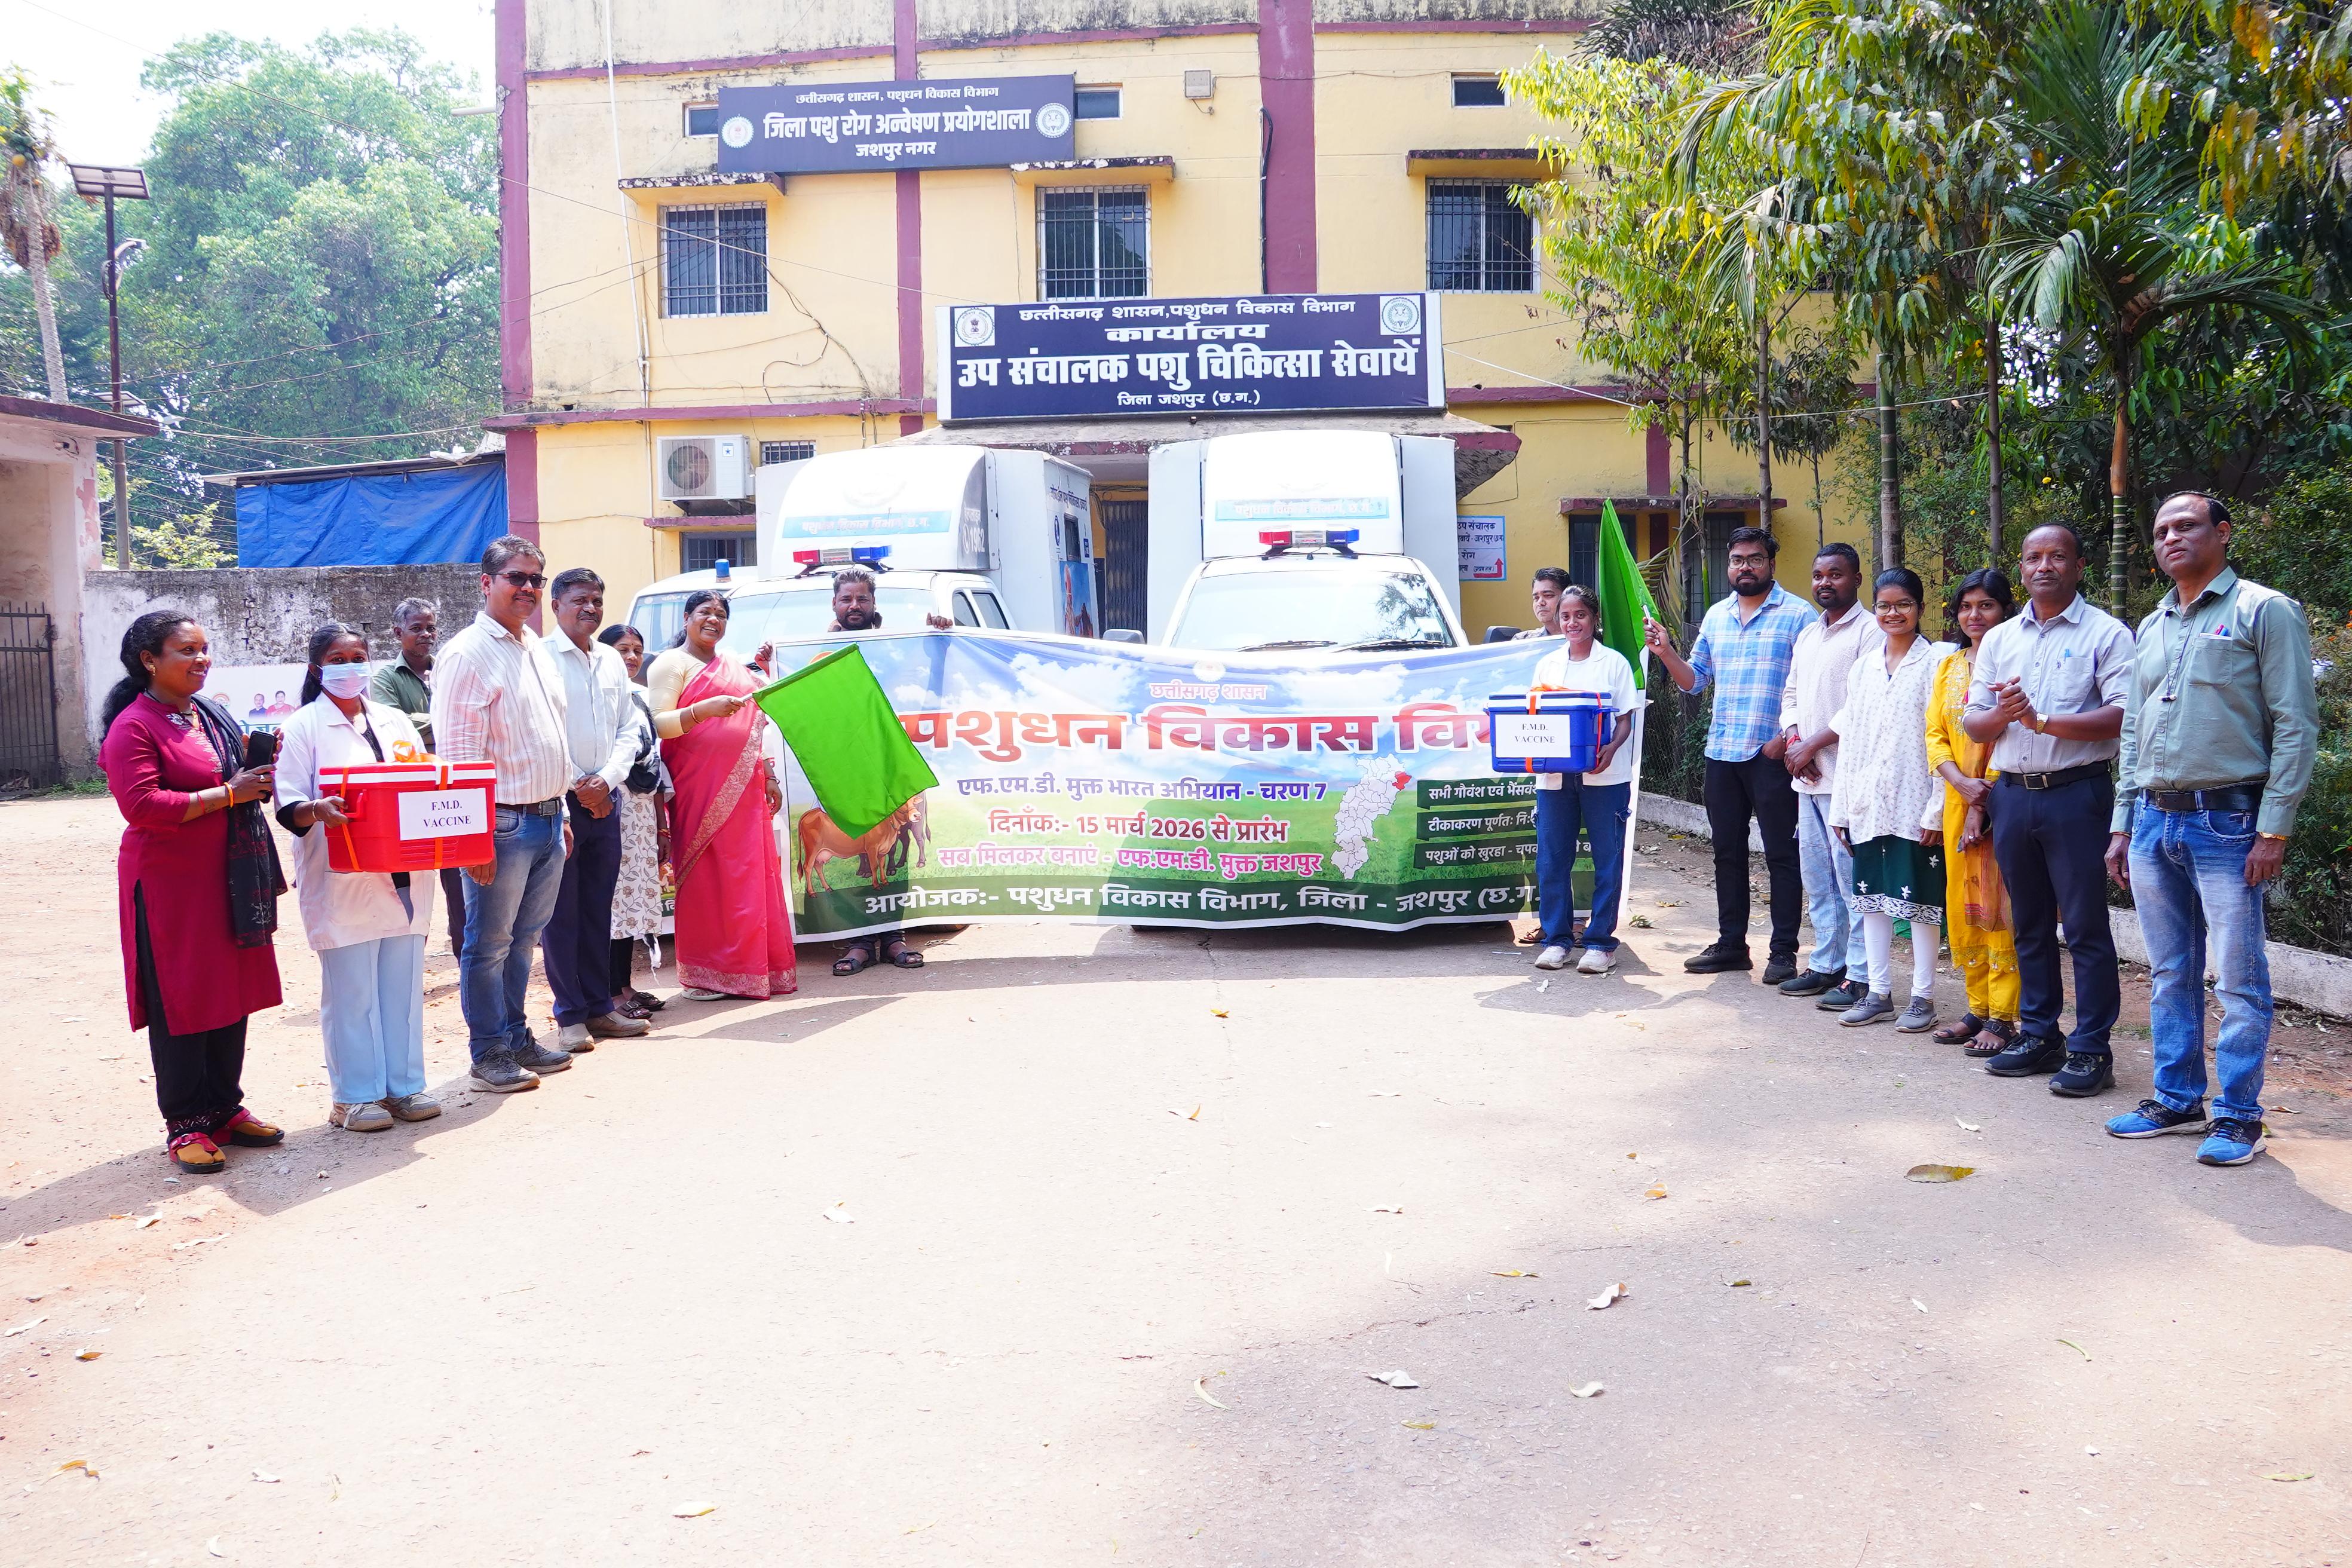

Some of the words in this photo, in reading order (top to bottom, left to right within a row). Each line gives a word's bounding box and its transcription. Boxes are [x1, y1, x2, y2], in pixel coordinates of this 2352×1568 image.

[847, 91, 884, 102] शासन,
[887, 90, 923, 103] पशुधन
[925, 87, 961, 99] विकास
[963, 85, 999, 97] विभाग
[763, 112, 808, 139] जिला
[809, 116, 839, 143] पशु
[840, 109, 872, 136] रोग
[875, 106, 941, 134] अन्वेषण
[942, 105, 1032, 133] प्रयोगशाला
[855, 142, 904, 161] जशपुर
[904, 142, 937, 155] नगर
[1019, 305, 1104, 321] छत्तीसगढ़
[1236, 299, 1295, 316] विकास
[1302, 298, 1355, 314] विभाग
[1104, 321, 1270, 342] कार्यालय
[956, 359, 1001, 387] उप
[1007, 347, 1130, 385] संचालक
[1136, 352, 1192, 391] पशु
[1197, 342, 1324, 380] चिकित्सा
[1330, 338, 1421, 377] सेवायें
[1117, 391, 1153, 406] जिला
[1158, 393, 1205, 408] जशपुर
[1212, 389, 1261, 407] (छ.ग.)
[1468, 520, 1496, 532] संचालक
[969, 527, 985, 553] 1962
[1474, 535, 1493, 544] जशपुर
[1461, 549, 1475, 561] रोग
[1151, 681, 1219, 701] छत्तीसगढ़
[1223, 685, 1266, 699] शासन
[899, 710, 1127, 762] पशुधन
[1141, 705, 1379, 751] विकास
[957, 771, 1061, 795] एफ.एम.डी.
[1065, 777, 1104, 801] मुक्त
[1108, 779, 1154, 797] भारत
[1160, 777, 1241, 800] अभियान
[1260, 783, 1309, 800] चरण
[1315, 783, 1327, 800] 7
[1429, 784, 1451, 800] सभी
[1454, 783, 1484, 798] गौवंश
[1487, 782, 1505, 797] एवं
[431, 800, 462, 811] F.M.D.
[424, 816, 471, 828] VACCINE
[1076, 816, 1098, 834] 15
[1105, 811, 1146, 835] मार्च
[1152, 819, 1205, 839] 2026
[1211, 814, 1231, 841] से
[1236, 816, 1287, 841] प्रारंभ
[1428, 817, 1482, 831] टीकाकरण
[939, 849, 971, 865] सब
[976, 843, 1045, 865] मिलकर
[1049, 844, 1098, 865] बनाएं
[1116, 847, 1214, 870] एफ.एम.डी.
[1220, 855, 1257, 878] मुक्त
[1262, 855, 1322, 875] जशपुर
[1425, 847, 1459, 865] पशुओं
[1460, 845, 1477, 859] को
[1478, 845, 1506, 862] खुरहा
[1007, 886, 1094, 911] पशुधन
[1100, 883, 1192, 909] विकास
[1197, 886, 1288, 911] विभाग,
[1297, 886, 1368, 909] जिला
[1395, 890, 1471, 912] जशपुर
